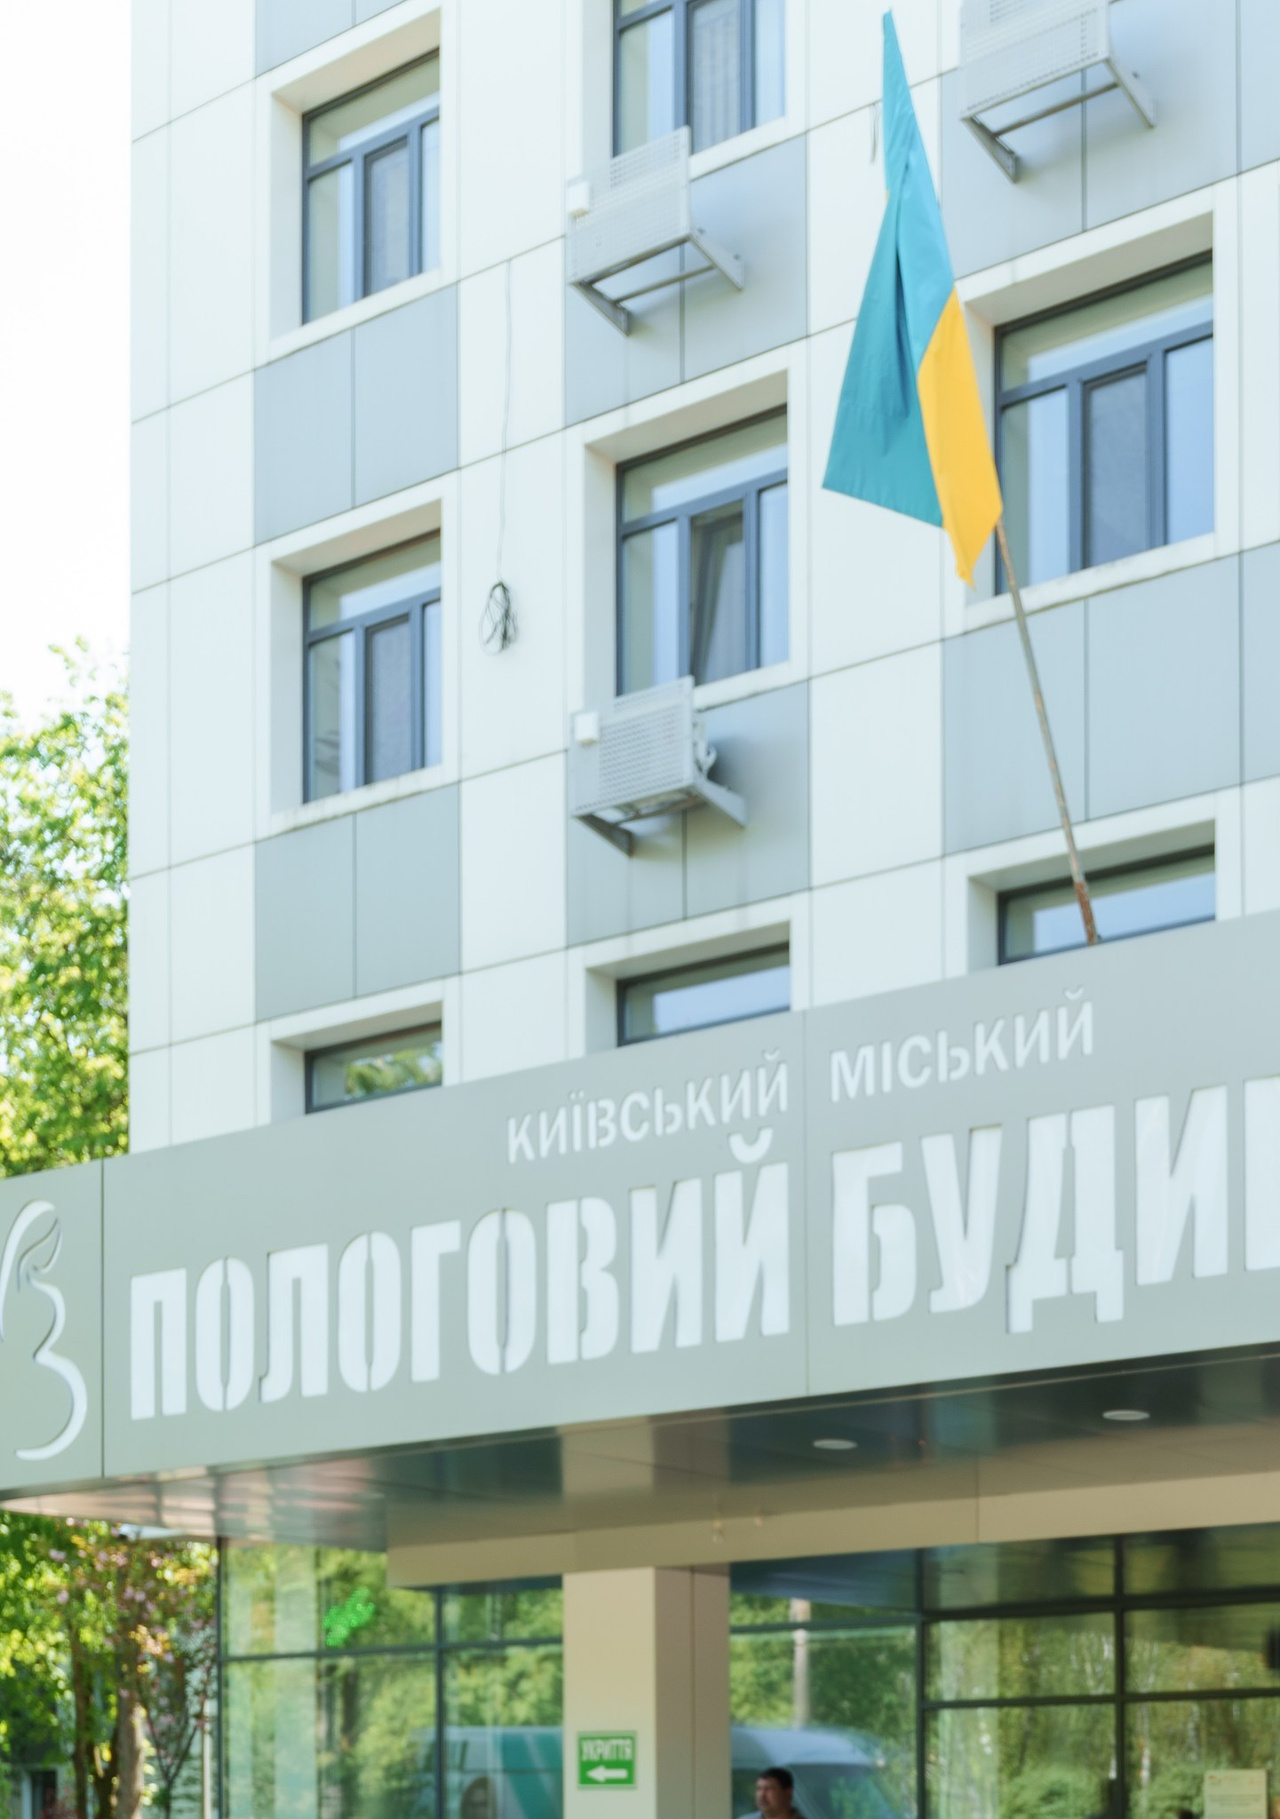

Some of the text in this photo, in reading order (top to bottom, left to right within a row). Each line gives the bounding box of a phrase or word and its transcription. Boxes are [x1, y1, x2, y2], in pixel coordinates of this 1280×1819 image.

[507, 986, 1094, 1165] КИЇВСЬКИЙ МІСЬКИЙ
[130, 1128, 791, 1421] ПОЛОГОВИЙ
[582, 1738, 633, 1762] УКРИТТЯ
